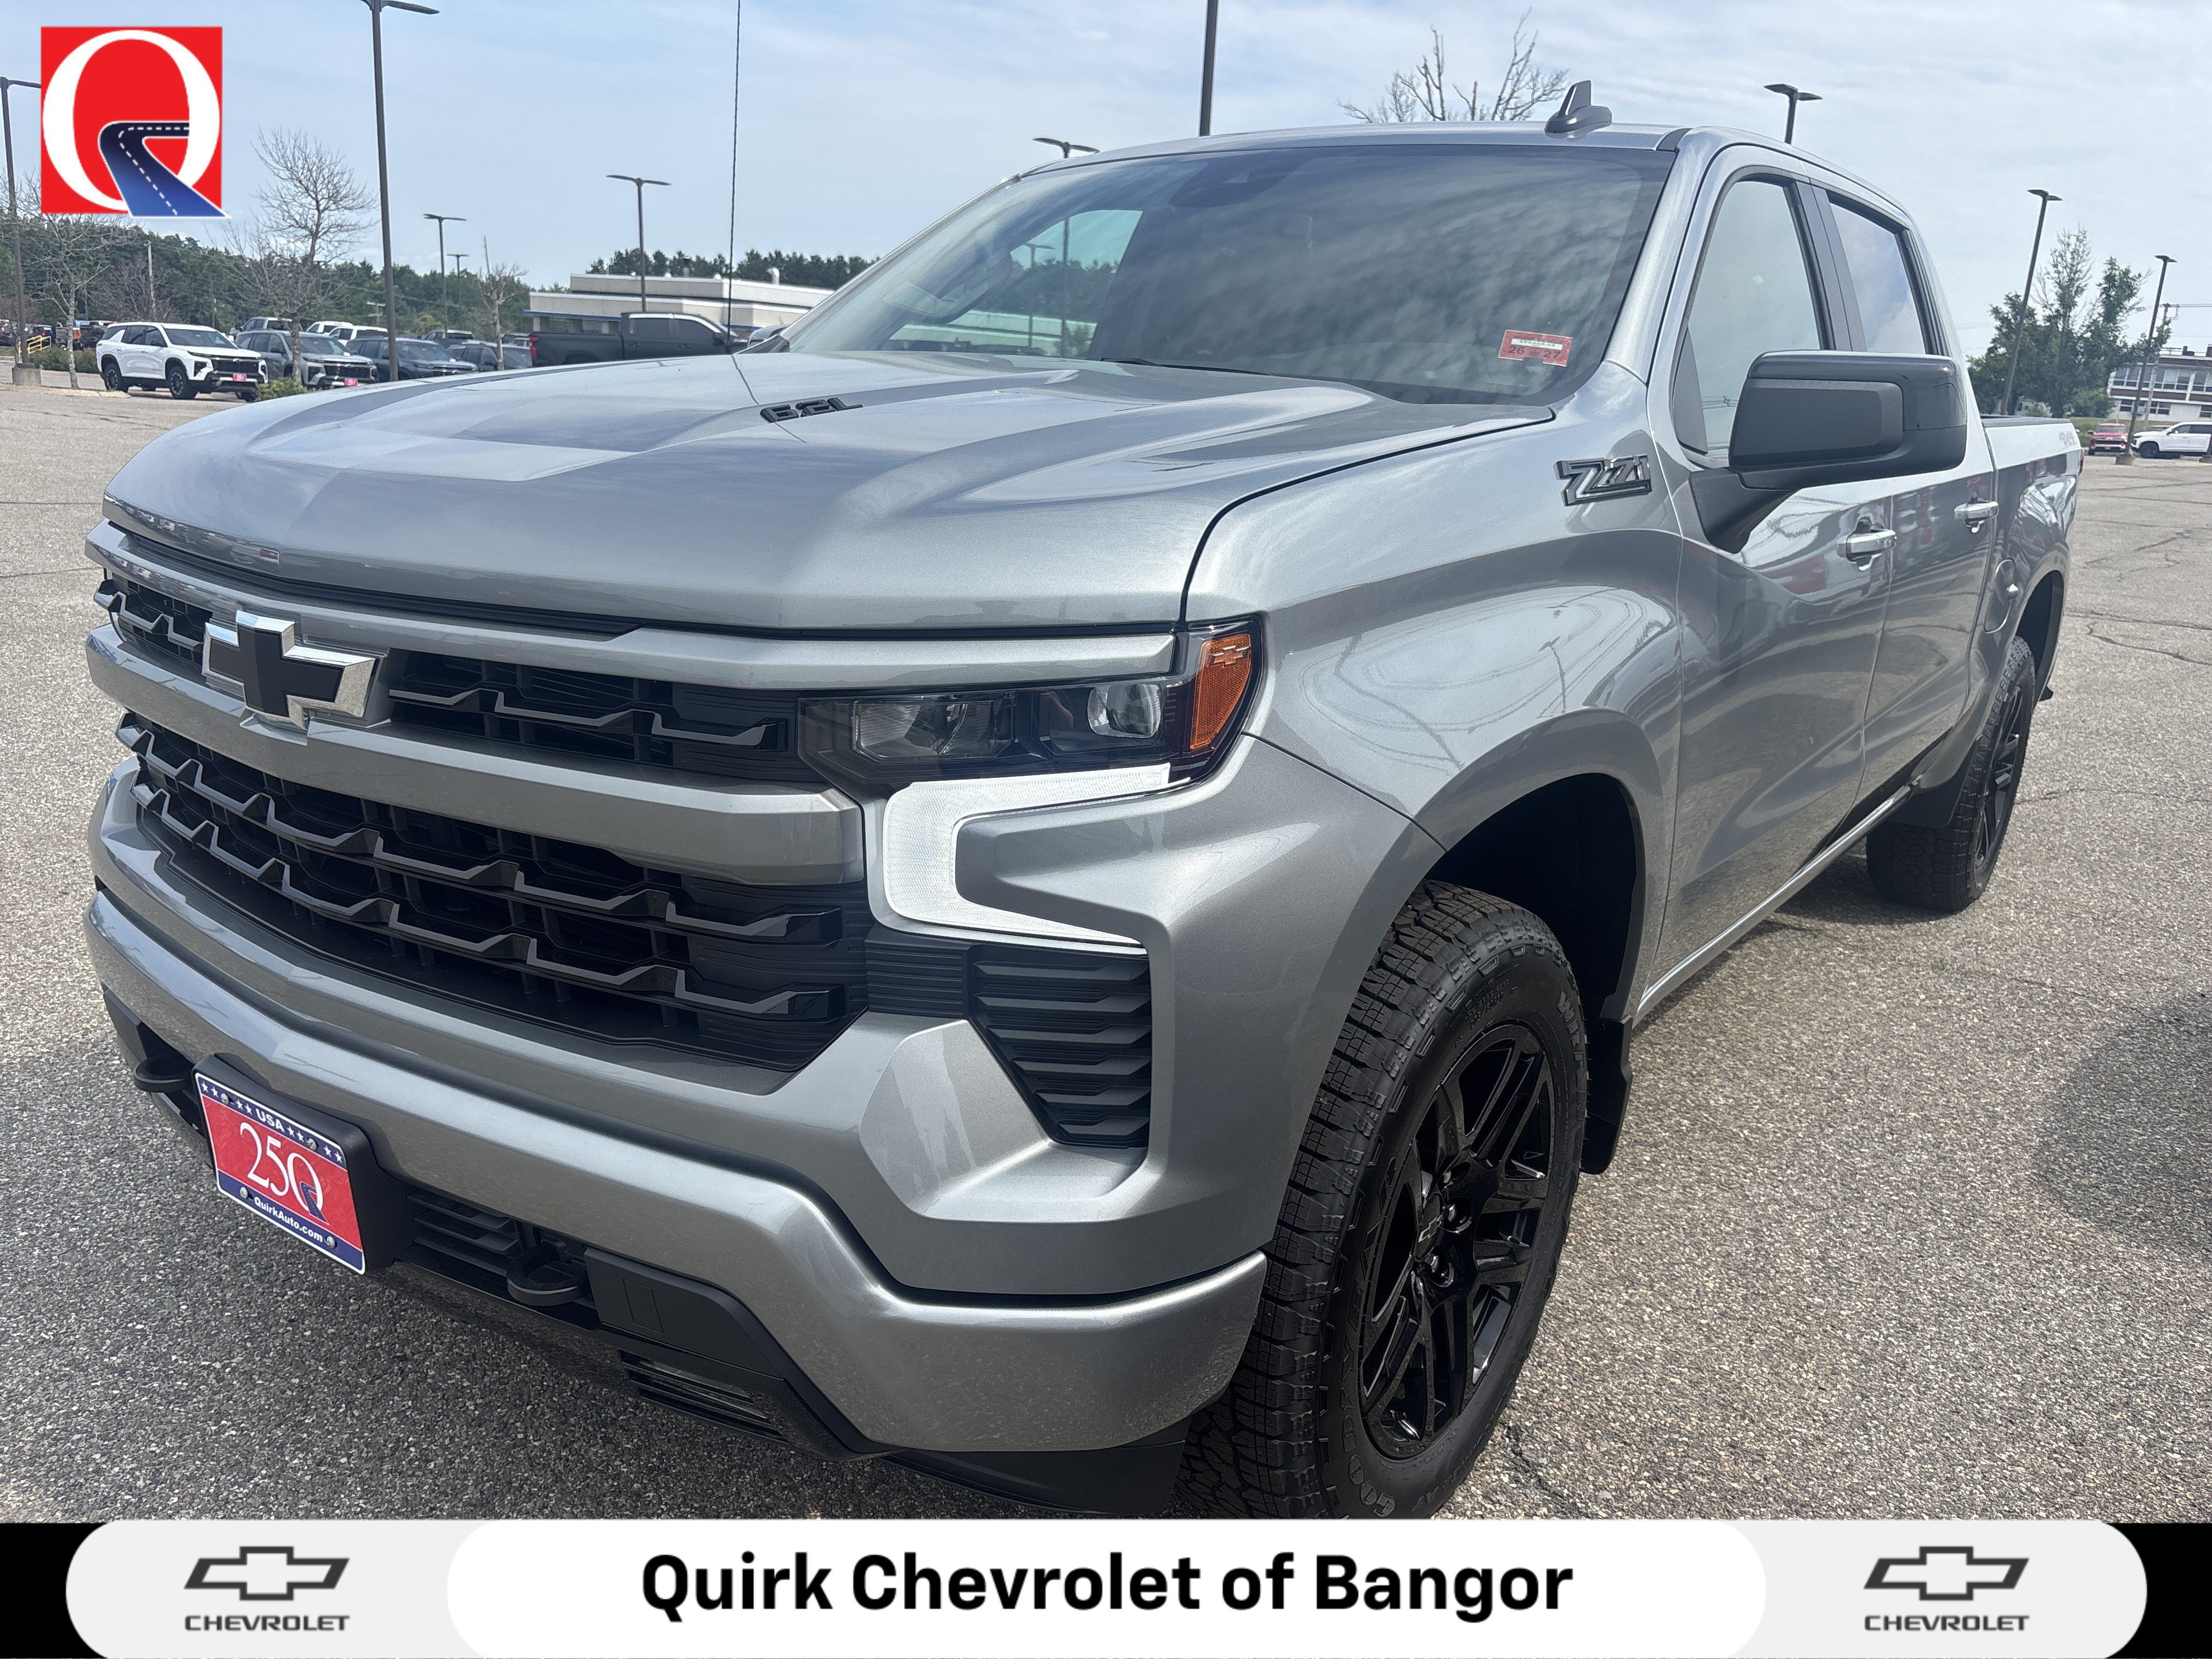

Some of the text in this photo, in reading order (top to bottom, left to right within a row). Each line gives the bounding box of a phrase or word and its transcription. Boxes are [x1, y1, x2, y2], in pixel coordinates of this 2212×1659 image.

[1508, 346, 1561, 359] 26 27
[1554, 455, 1652, 507] Z71
[256, 1107, 285, 1133] USA
[240, 1122, 325, 1214] 250
[254, 1196, 324, 1243] QuirkAuto.com
